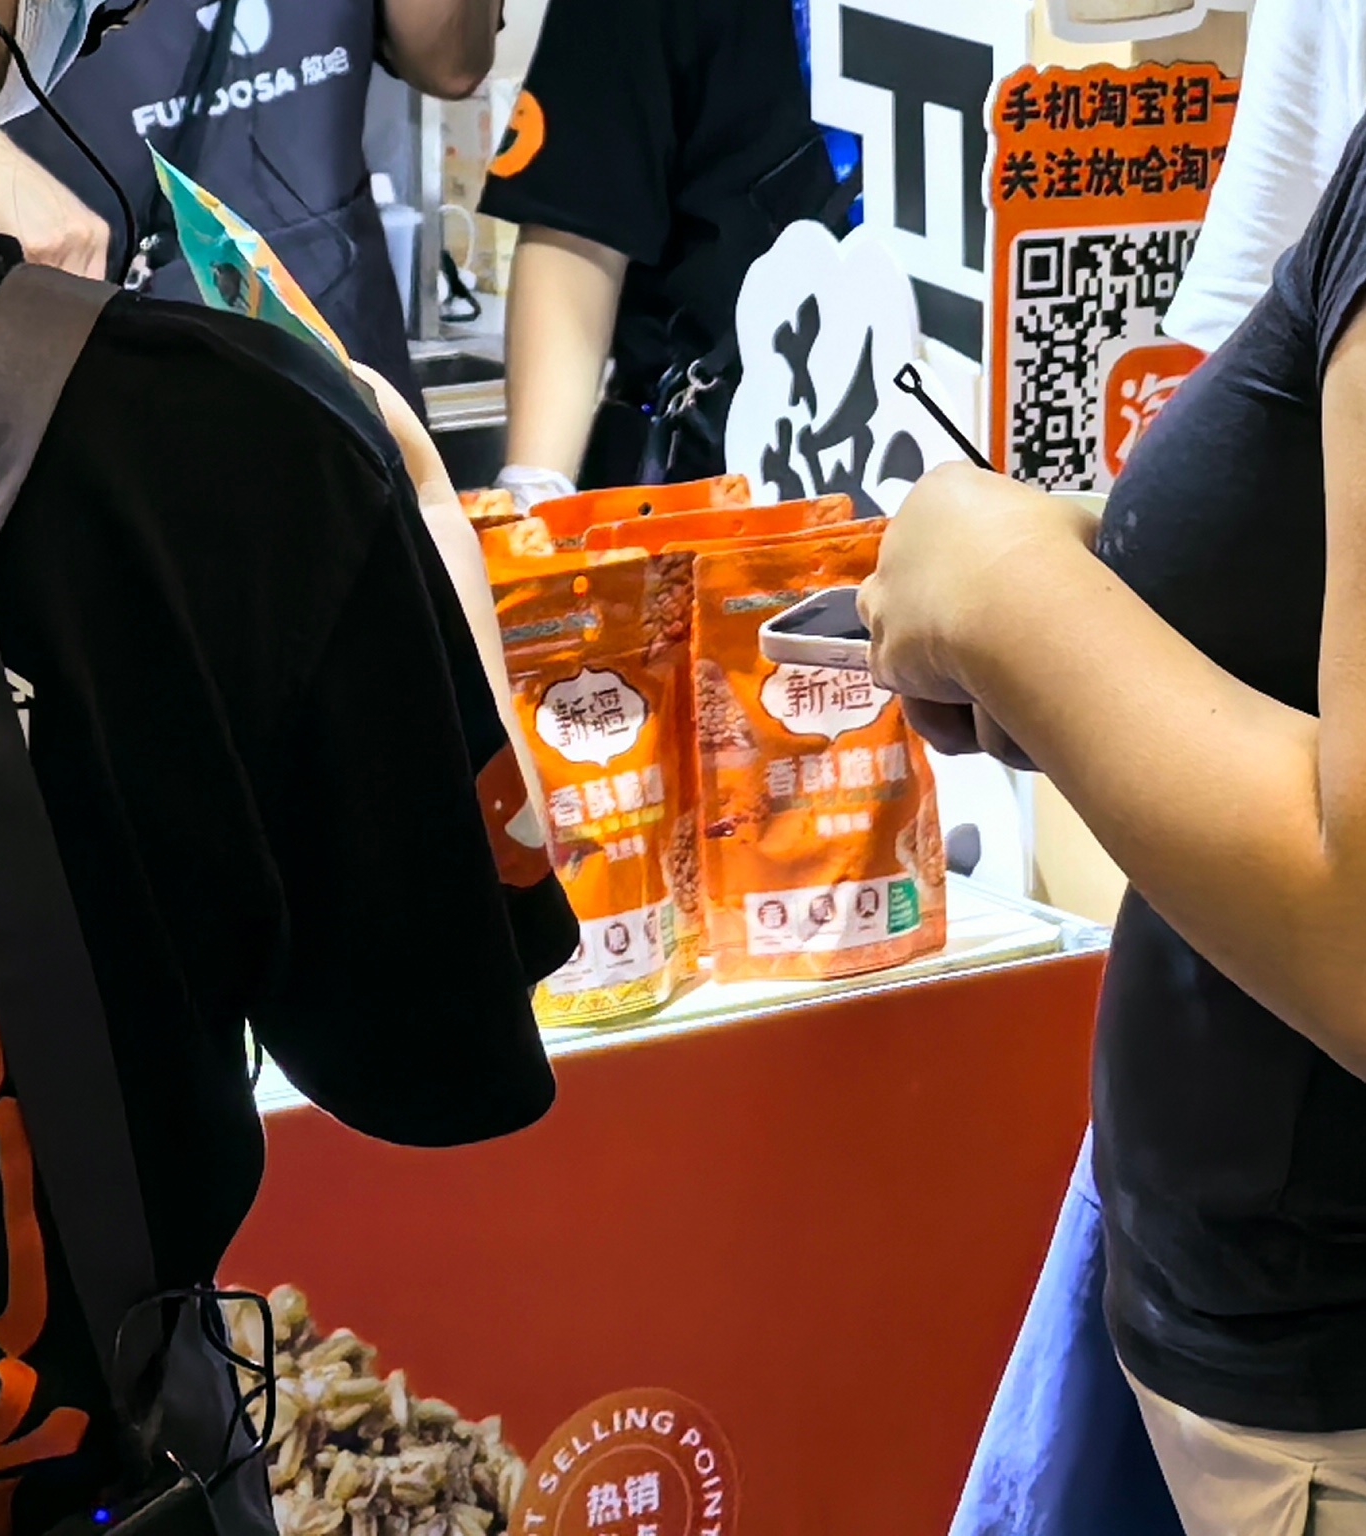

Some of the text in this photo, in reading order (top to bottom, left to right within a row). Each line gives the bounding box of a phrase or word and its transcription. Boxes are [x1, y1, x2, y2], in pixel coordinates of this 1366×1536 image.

[1001, 144, 1227, 201] 关注放哈淘
[539, 1406, 675, 1495] SELLING
[587, 1471, 660, 1528] 热销
